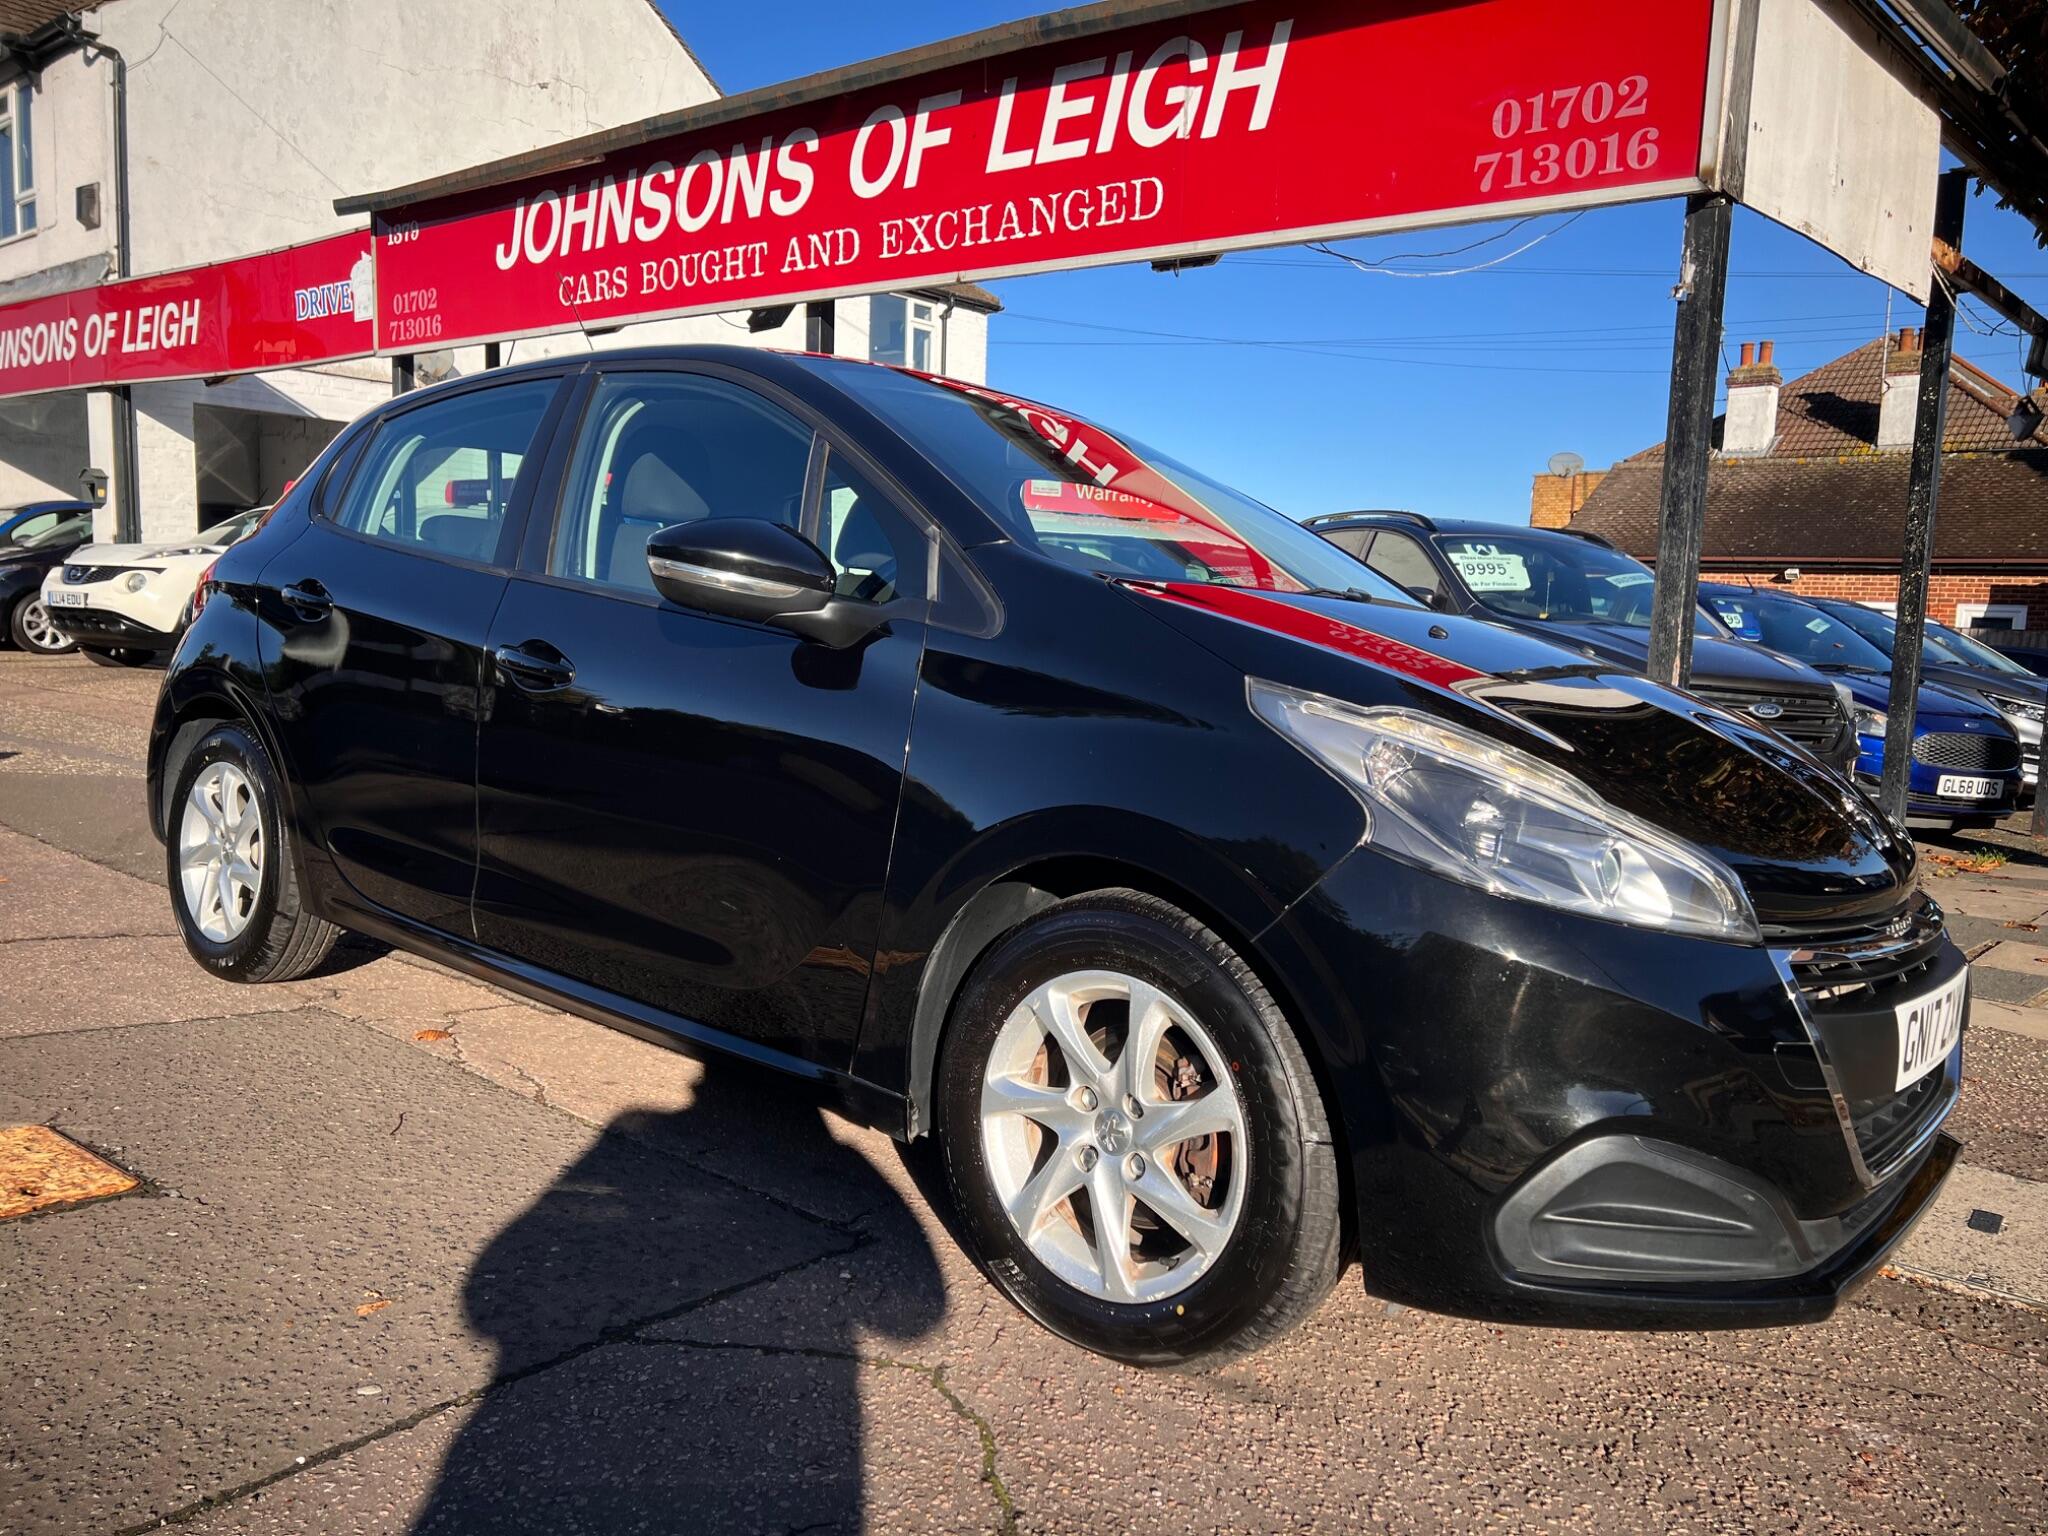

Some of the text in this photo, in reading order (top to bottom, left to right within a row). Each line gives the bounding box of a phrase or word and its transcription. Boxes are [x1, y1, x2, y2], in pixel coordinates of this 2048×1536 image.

[1492, 75, 1649, 140] 01702
[495, 19, 1294, 270] JOHNSONS OF LEIGH
[1473, 127, 1660, 193] 713016
[558, 176, 1165, 307] CARS BOUGHT AND EXCHANGED
[84, 312, 118, 358] OF
[121, 298, 201, 353] LEIGH
[295, 280, 352, 321] DRIVE
[389, 314, 442, 342] 713016
[393, 288, 438, 316] 01702
[1942, 778, 2000, 796] GL68 UDS
